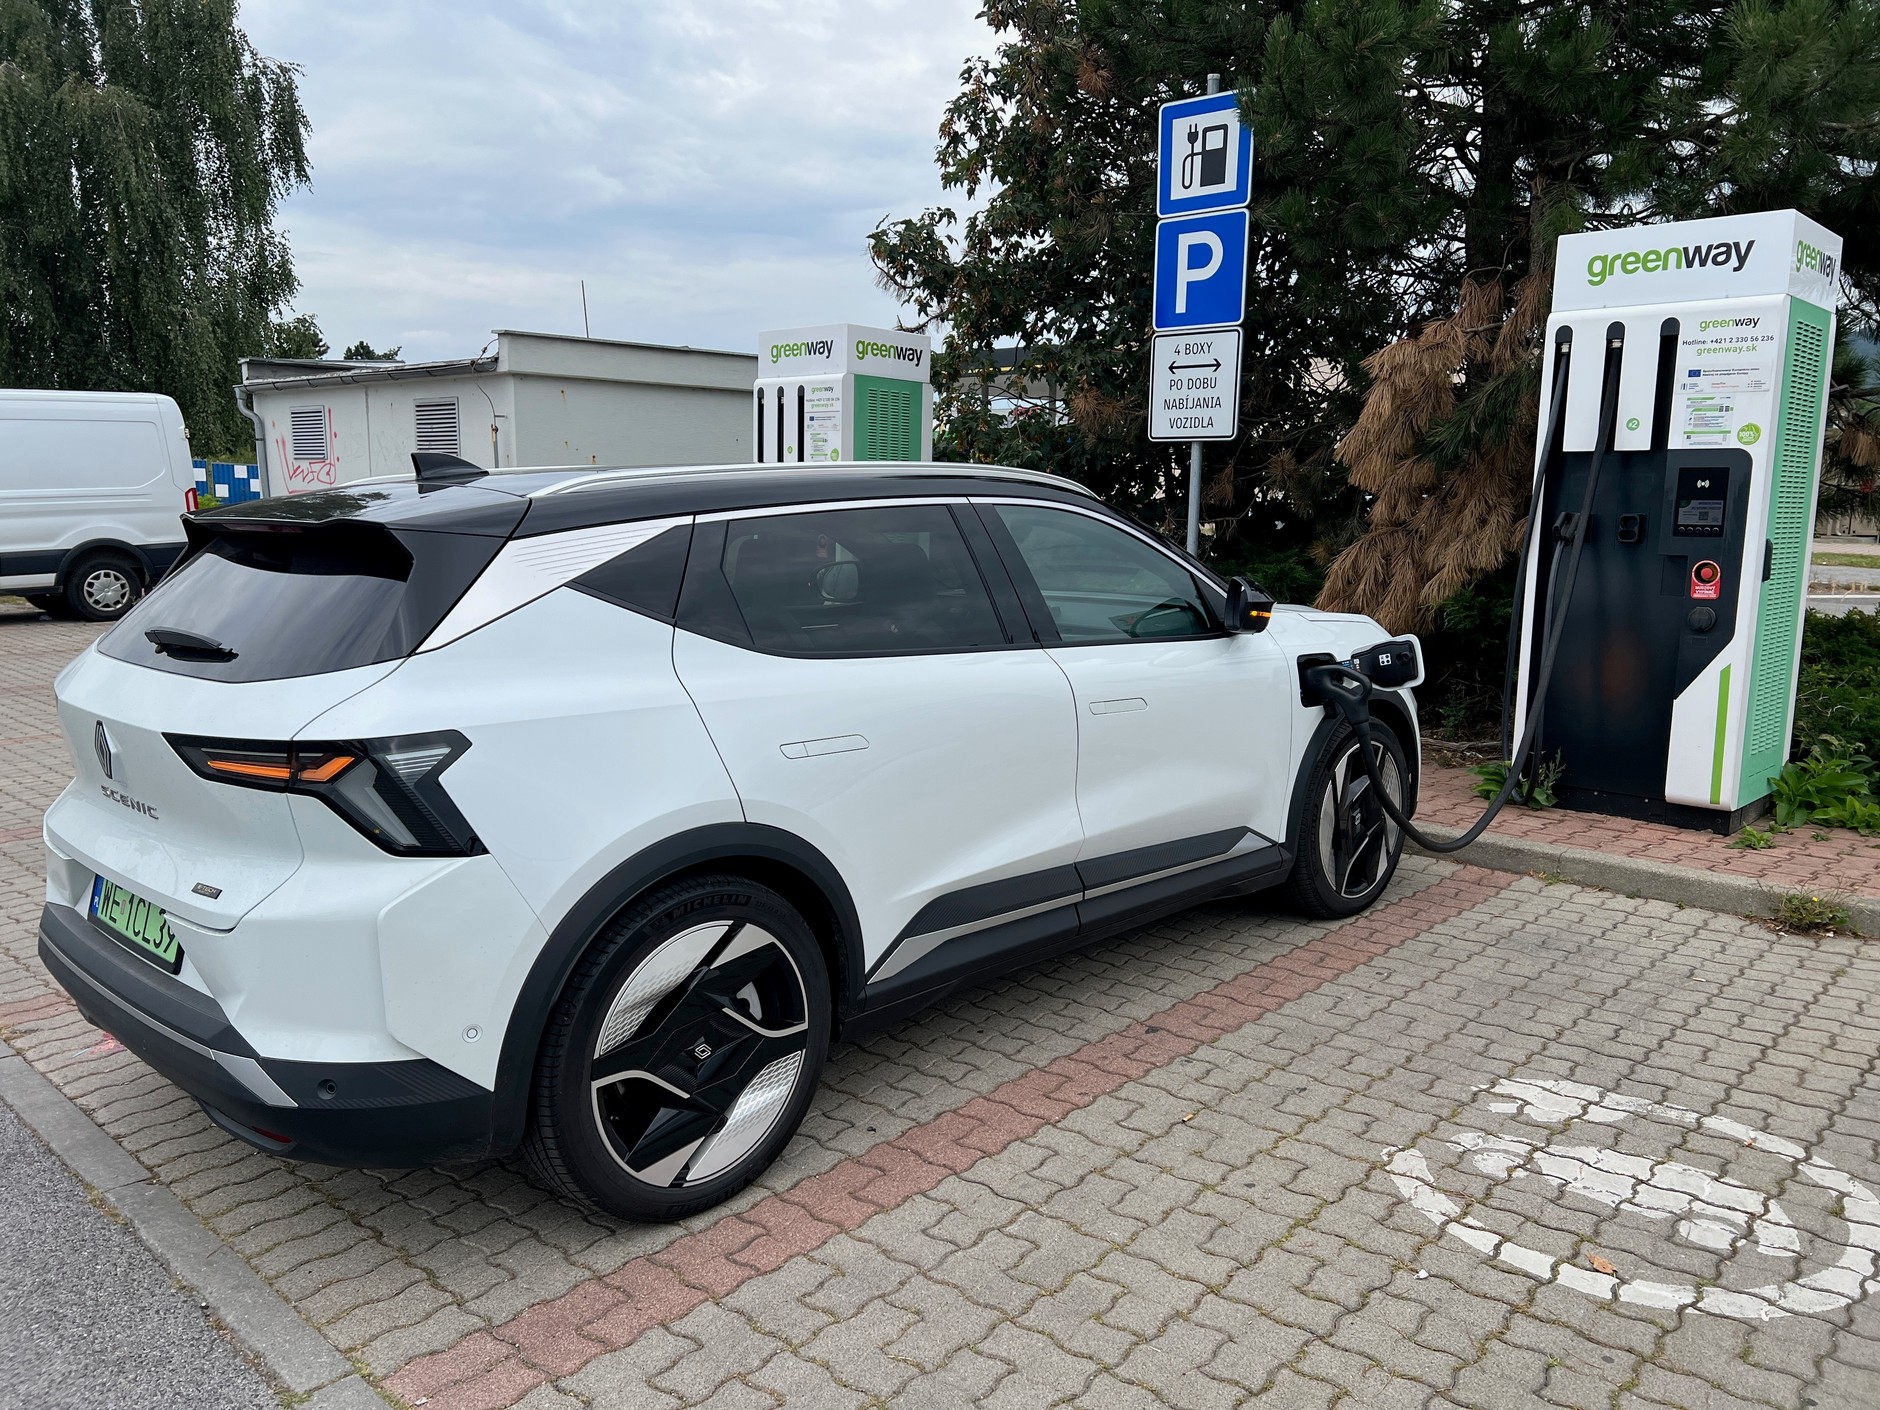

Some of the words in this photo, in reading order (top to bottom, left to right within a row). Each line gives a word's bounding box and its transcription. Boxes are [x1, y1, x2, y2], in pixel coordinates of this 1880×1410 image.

[1174, 230, 1224, 314] P
[1587, 239, 1756, 287] greenway
[1796, 239, 1837, 287] greenway
[1699, 316, 1761, 332] greenway
[770, 339, 834, 364] greenway
[855, 339, 923, 367] greenway
[1174, 344, 1181, 356] 4
[1184, 341, 1213, 355] BOXY
[1696, 343, 1758, 356] greenway.sk
[1169, 379, 1183, 391] PO
[1187, 377, 1217, 390] DOBU
[1163, 395, 1222, 411] NABÍJANIA
[1169, 416, 1214, 429] VOZIDLA
[100, 784, 160, 821] SCENIC
